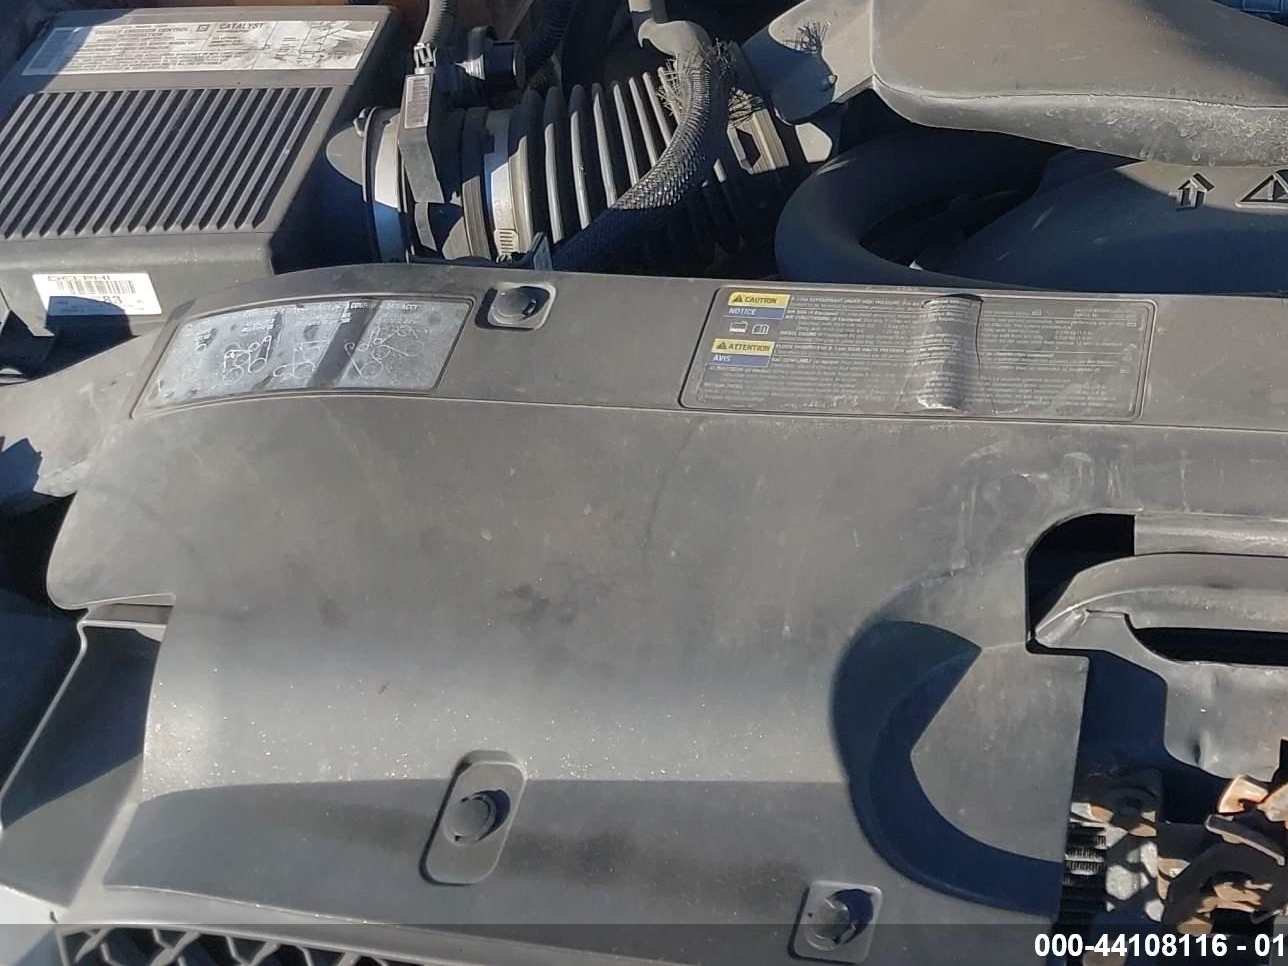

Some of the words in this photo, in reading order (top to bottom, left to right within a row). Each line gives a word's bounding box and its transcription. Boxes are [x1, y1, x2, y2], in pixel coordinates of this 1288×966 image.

[219, 22, 265, 30] CATALYST
[744, 296, 778, 304] CAUTION
[728, 307, 757, 315] NOTICE
[728, 343, 771, 352] ATTENTION
[712, 354, 731, 362] AVIS
